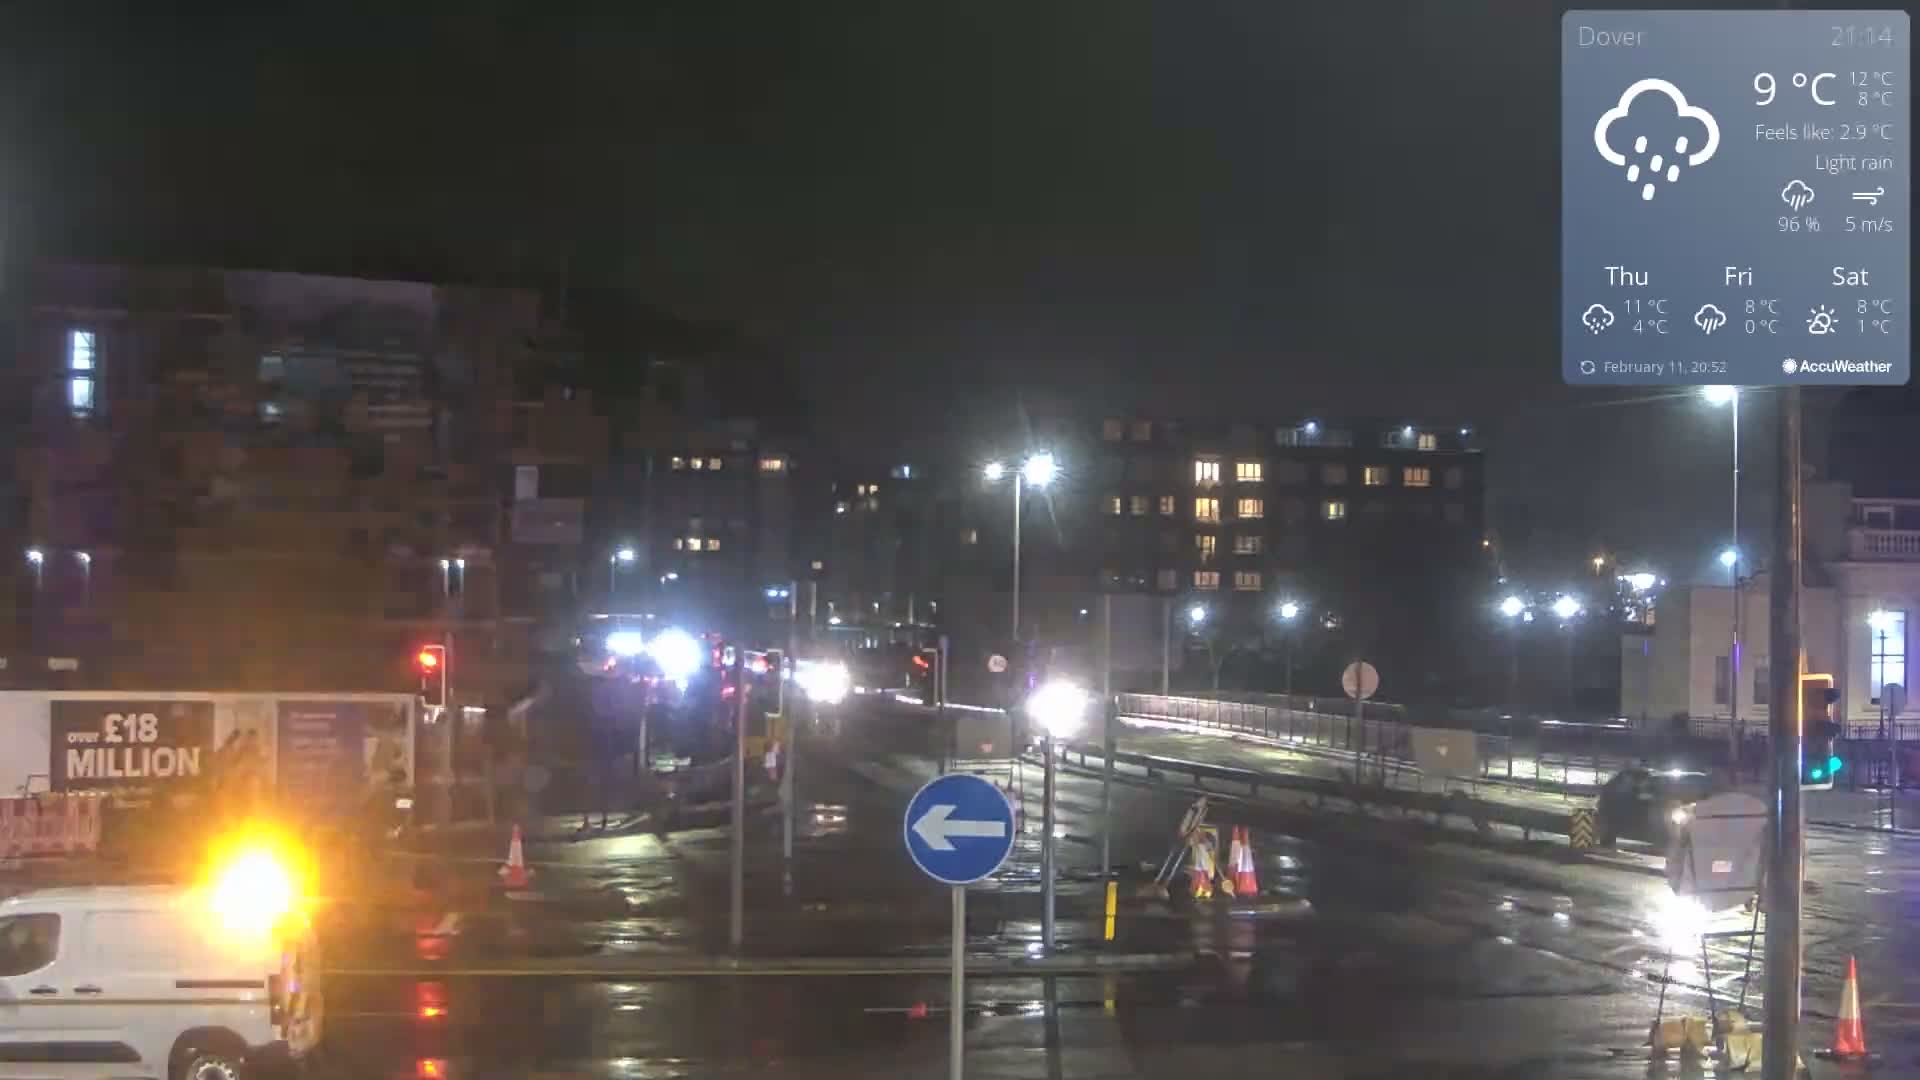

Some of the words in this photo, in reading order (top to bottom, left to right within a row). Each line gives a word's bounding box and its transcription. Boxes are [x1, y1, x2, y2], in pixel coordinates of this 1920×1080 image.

[67, 732, 99, 744] over
[105, 712, 158, 743] £18
[66, 746, 201, 780] MILLION
